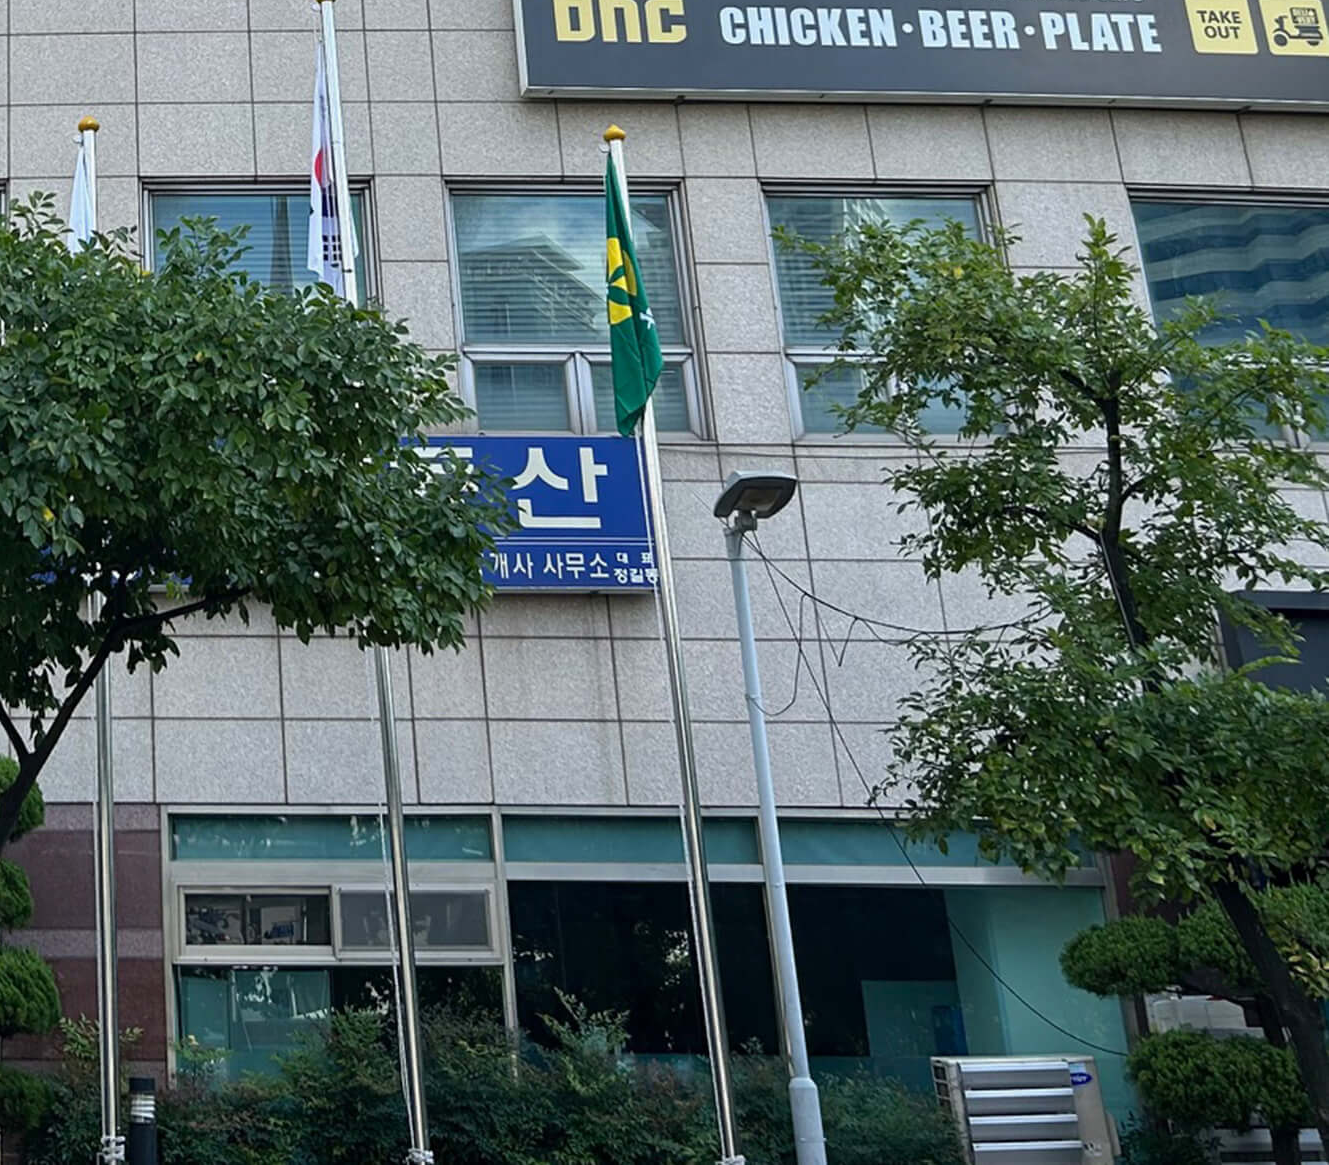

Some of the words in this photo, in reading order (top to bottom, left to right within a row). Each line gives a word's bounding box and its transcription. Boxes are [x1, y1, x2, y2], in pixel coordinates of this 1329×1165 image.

[1196, 9, 1243, 25] TAKE
[1203, 25, 1241, 40] OUT
[479, 551, 534, 580] 개사
[542, 551, 610, 580] 사무소
